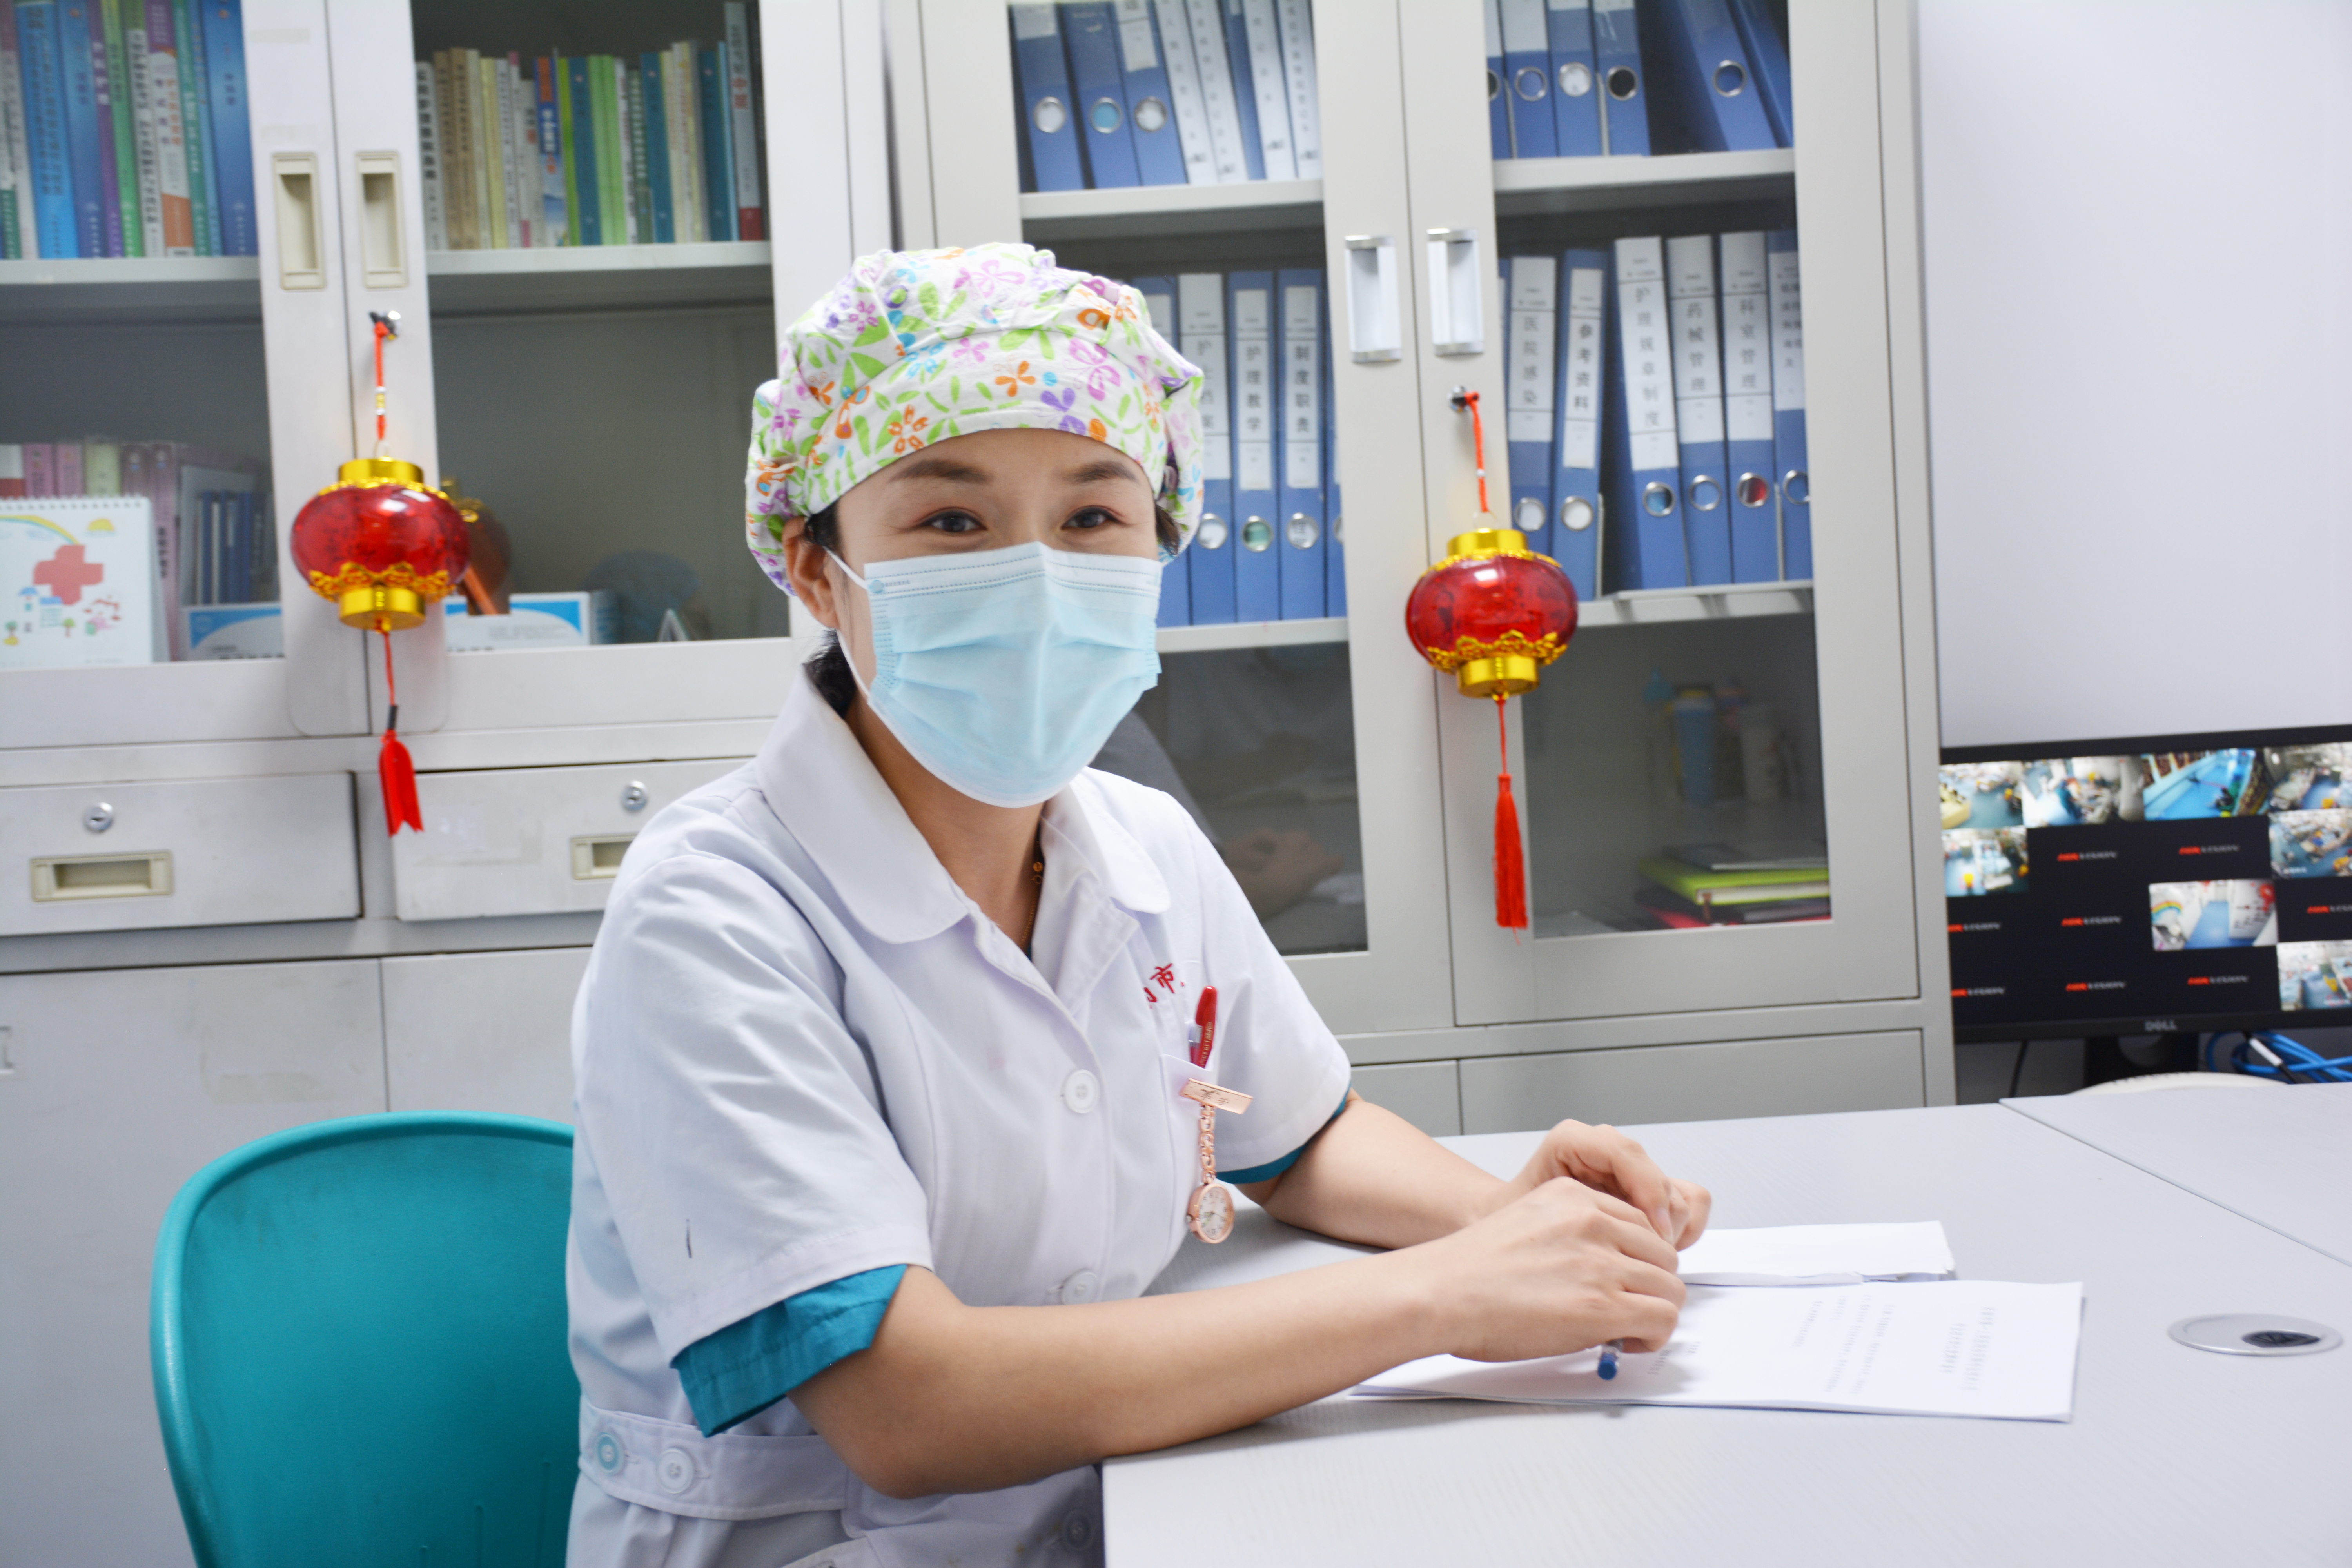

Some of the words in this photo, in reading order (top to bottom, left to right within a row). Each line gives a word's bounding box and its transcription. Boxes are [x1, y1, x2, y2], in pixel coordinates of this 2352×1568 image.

[1522, 316, 1539, 406] 医院感染
[1573, 324, 1593, 410] 参考资料
[1634, 286, 1660, 427] 护理规章制度
[1740, 298, 1757, 389] 科室管理
[1246, 346, 1262, 432] 护理教学
[1294, 345, 1311, 432] 制度职责
[2144, 1020, 2178, 1032] DELL
